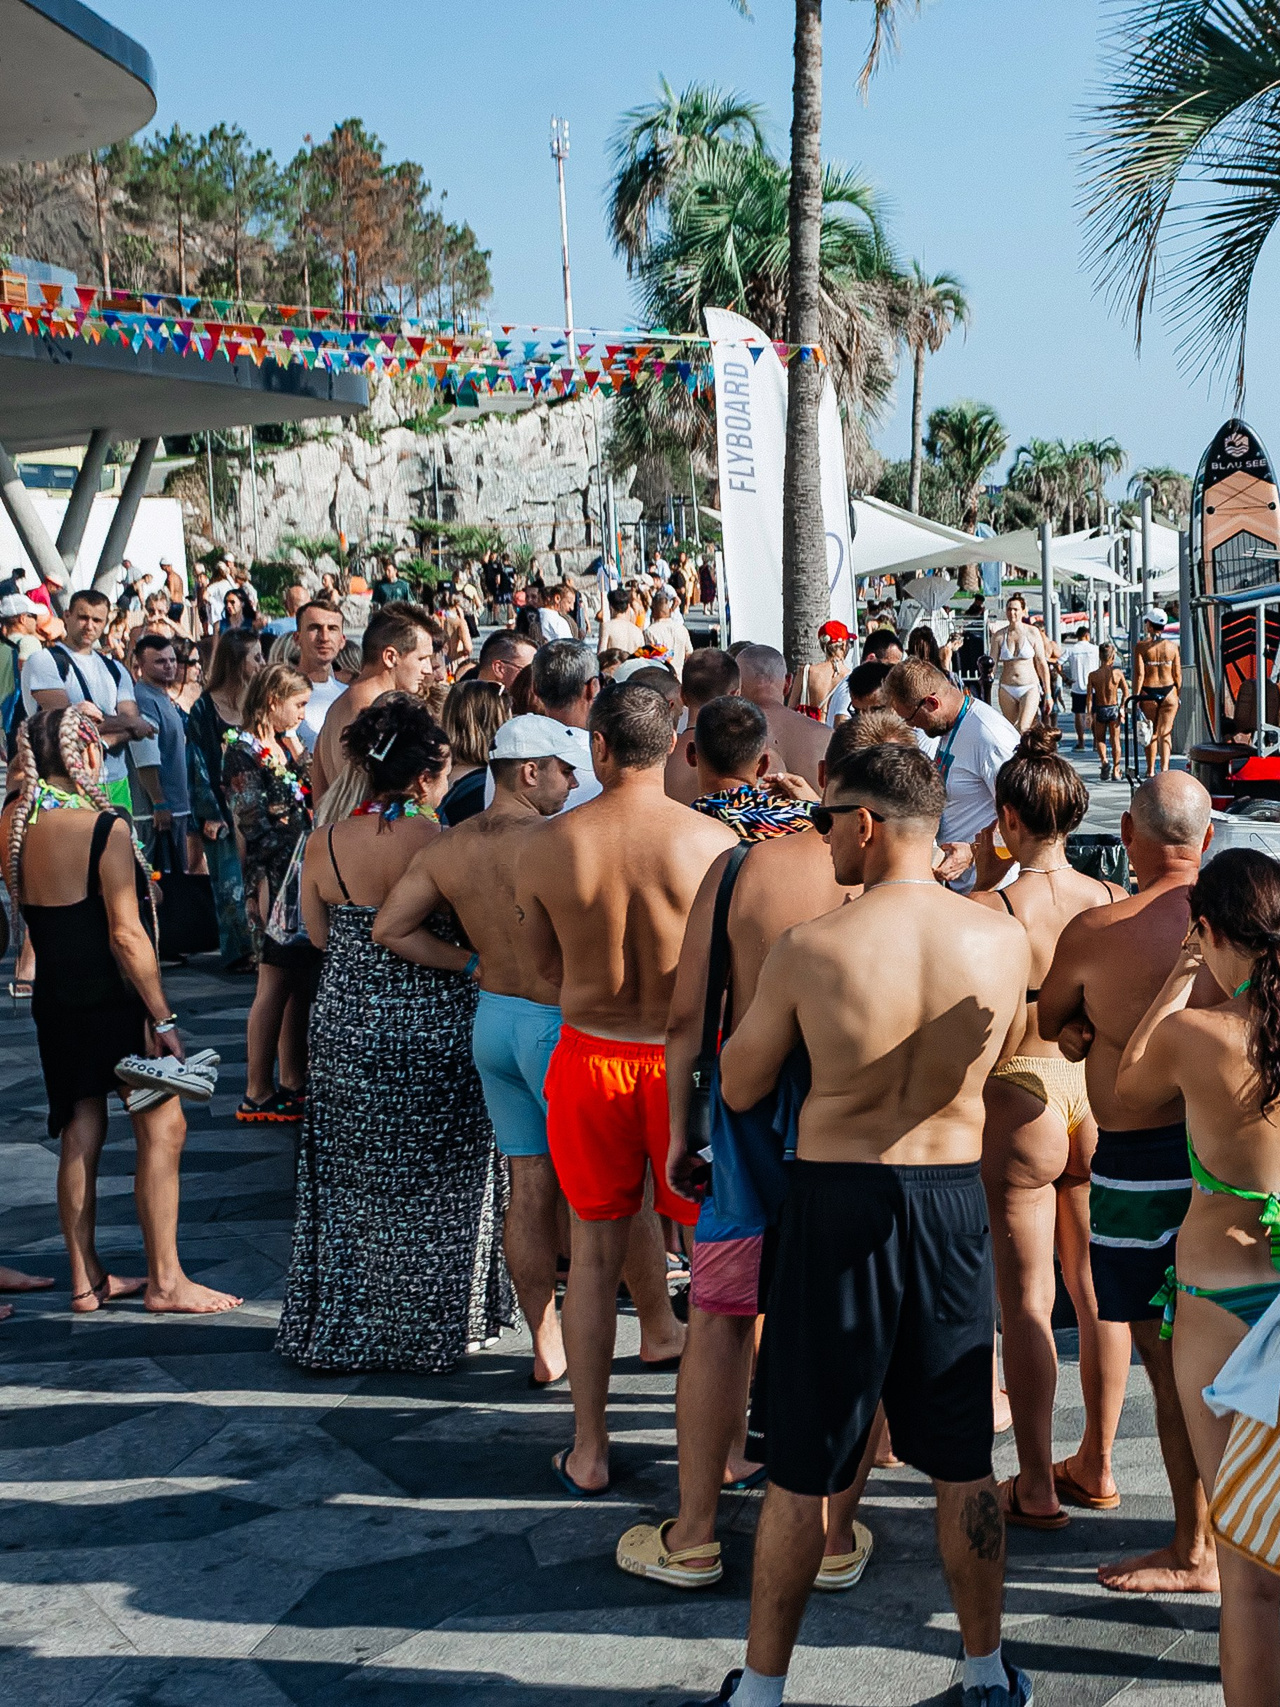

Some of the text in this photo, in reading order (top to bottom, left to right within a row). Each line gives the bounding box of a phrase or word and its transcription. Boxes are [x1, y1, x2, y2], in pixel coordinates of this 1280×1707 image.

[723, 361, 756, 493] FLYBOARD
[1211, 458, 1267, 470] BLAU SEE
[123, 1060, 163, 1078] crocs
